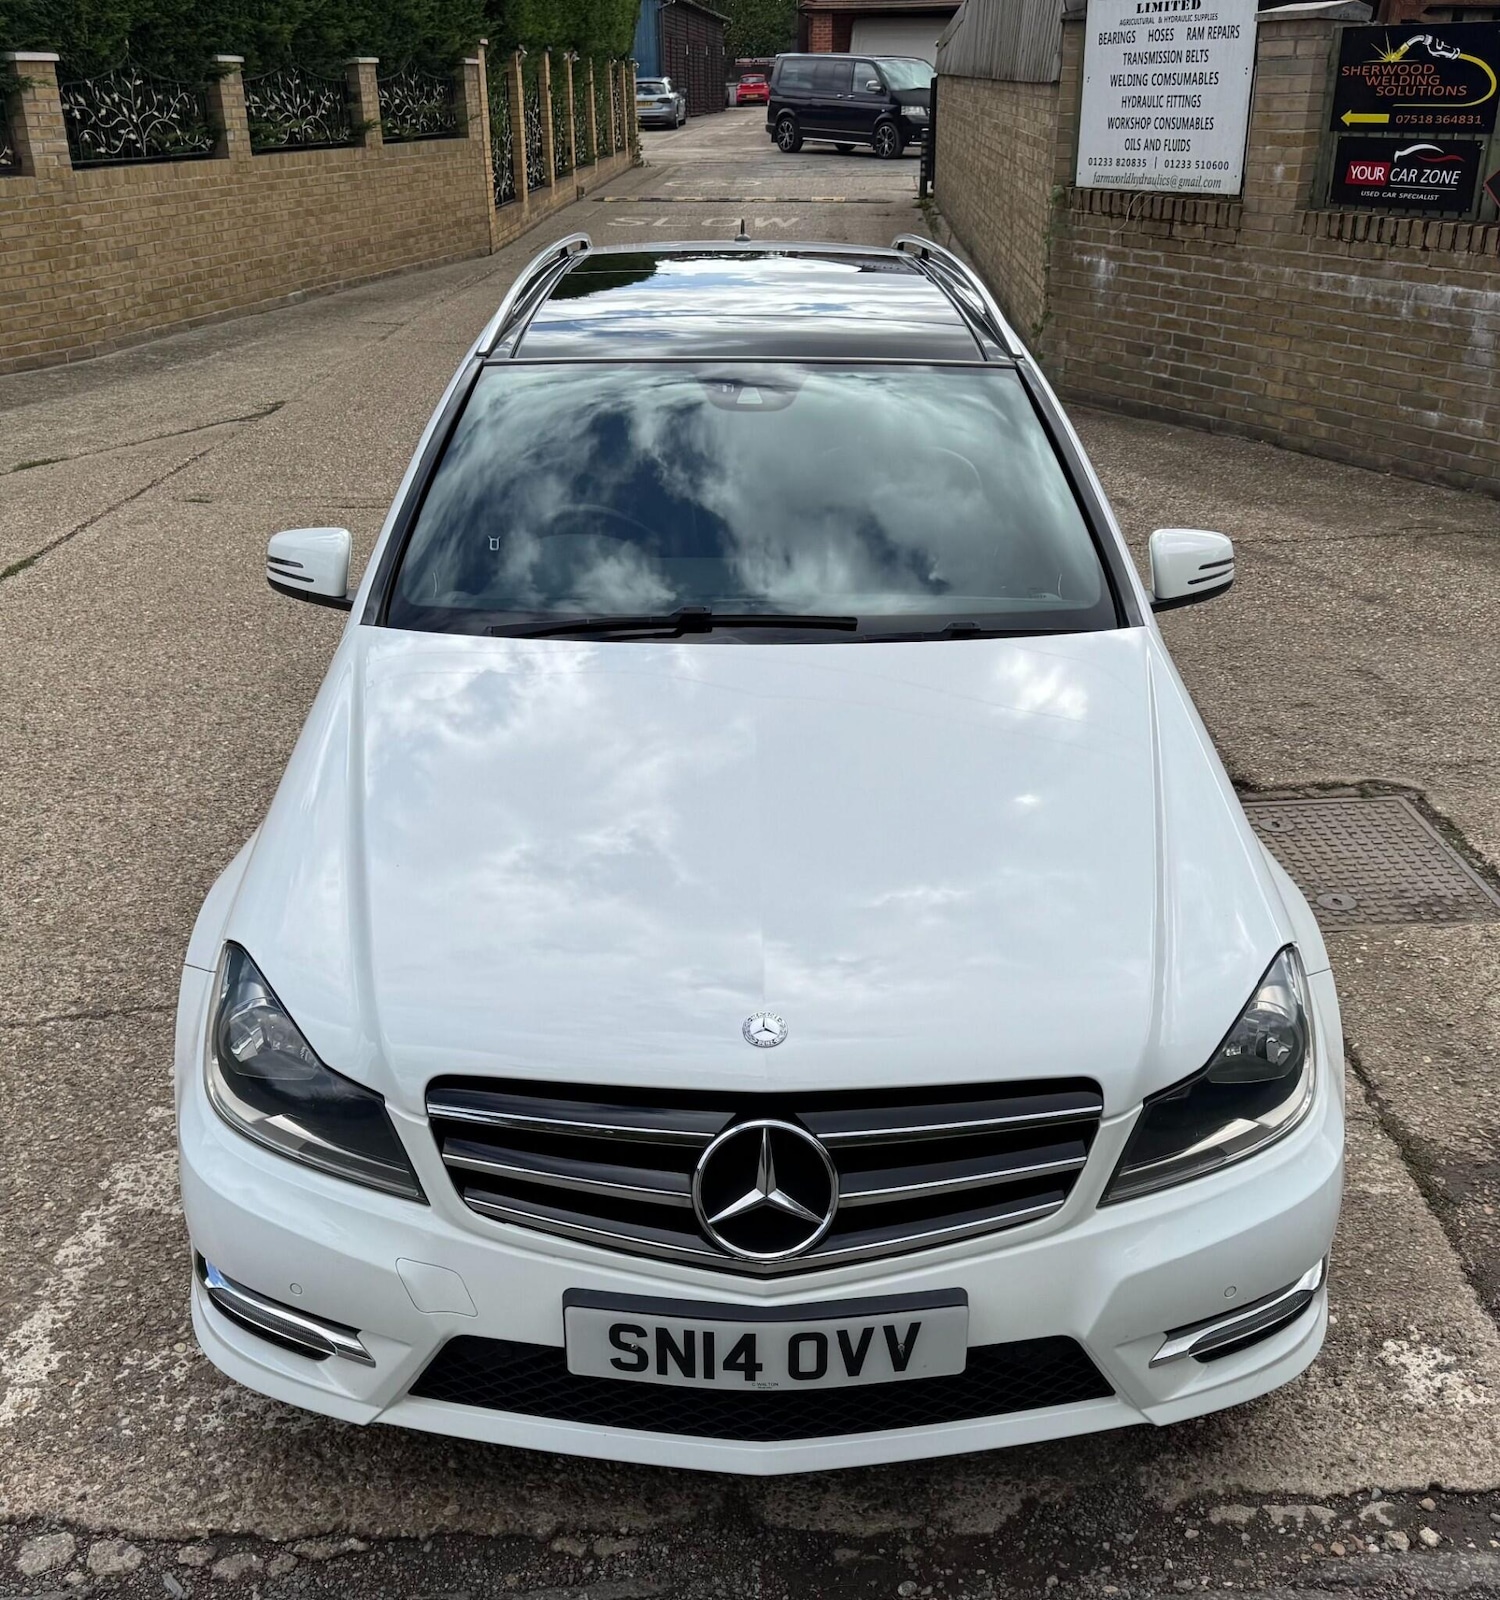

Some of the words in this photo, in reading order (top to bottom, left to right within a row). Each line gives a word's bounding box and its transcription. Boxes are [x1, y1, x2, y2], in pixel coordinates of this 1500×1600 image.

[1136, 0, 1201, 13] LIMITED
[1119, 17, 1155, 26] AGRICULTURAL
[1164, 14, 1193, 24] HYDRAULIC
[1194, 13, 1218, 22] SUPPLIES
[1098, 30, 1136, 46] BEARINGS
[1148, 28, 1174, 42] HOSES
[1186, 26, 1205, 41] RAM
[1207, 25, 1240, 40] REPAIRS
[1122, 50, 1182, 66] TRANSMISSION
[1185, 49, 1209, 64] BELTS
[1341, 64, 1435, 76] SHERWOOD
[1109, 73, 1148, 87] WELDING
[1151, 71, 1219, 86] COMSUMABLES
[1365, 75, 1440, 86] WELDING
[1376, 85, 1468, 97] SOLUTIONS
[1121, 95, 1164, 109] HYDRAULIC
[1165, 94, 1202, 109] FITTINGS
[1107, 116, 1151, 131] WORKSHOP
[1153, 116, 1214, 131] CONSUMABLES
[1395, 115, 1433, 125] 07518
[1435, 115, 1481, 125] 364831
[1124, 138, 1141, 151] OILS
[1143, 138, 1161, 152] AND
[1163, 138, 1191, 152] FLUIDS
[1087, 157, 1113, 167] 01233
[1115, 158, 1147, 168] 820835
[1164, 159, 1192, 169] 01233
[1194, 160, 1230, 170] 510600
[1350, 165, 1385, 181] YOUR
[1390, 167, 1418, 183] CAR
[1420, 169, 1461, 185] ZONE
[1360, 190, 1380, 198] USED
[1382, 191, 1397, 199] CAR
[1399, 192, 1440, 201] SPECIALIST
[606, 216, 801, 228] SLOW
[608, 1323, 763, 1382] SN14
[787, 1322, 922, 1381] OVV
